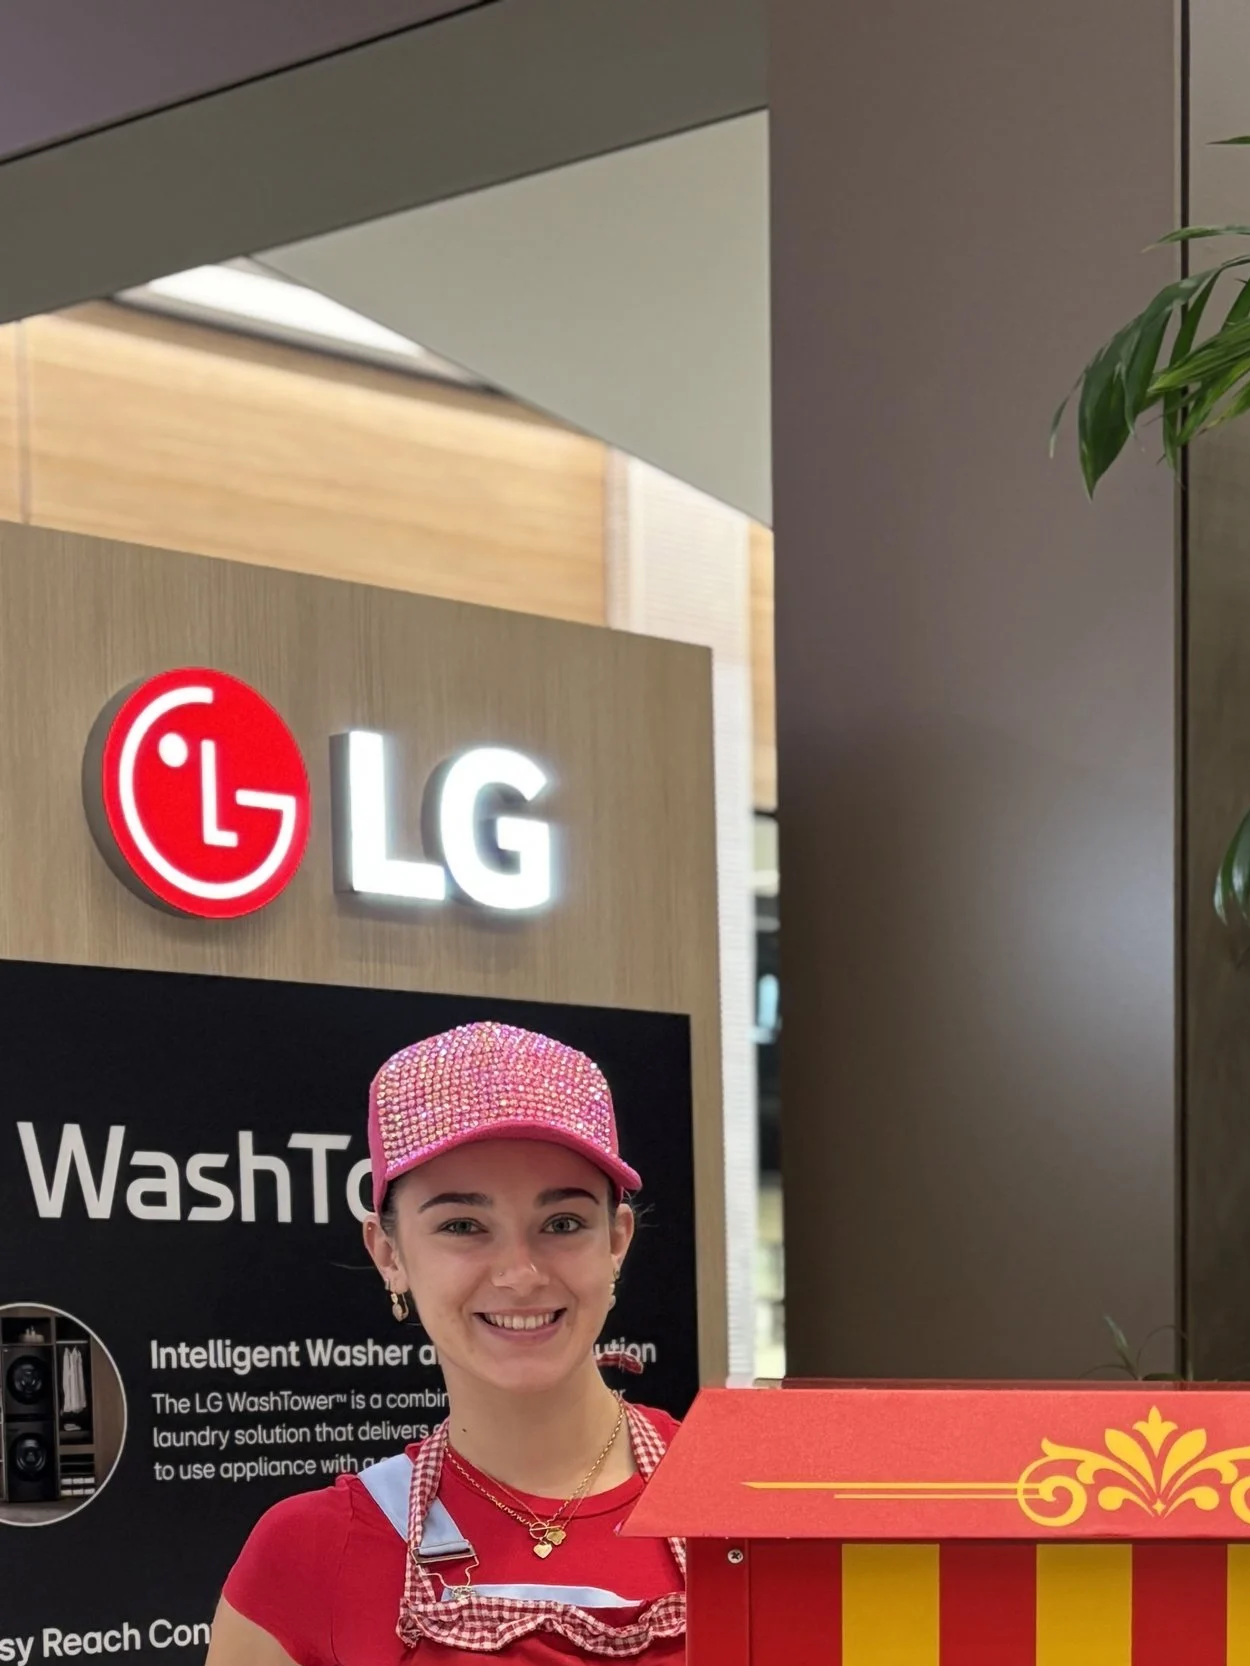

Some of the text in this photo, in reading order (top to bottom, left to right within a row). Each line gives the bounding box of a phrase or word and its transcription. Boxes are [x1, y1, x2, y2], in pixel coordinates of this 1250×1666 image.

[348, 730, 552, 910] LG
[151, 1339, 300, 1375] Intelligent
[306, 1338, 413, 1367] Washer
[152, 1393, 191, 1414] The
[195, 1392, 222, 1413] LG
[351, 1389, 366, 1410] is
[370, 1395, 382, 1409] a
[153, 1427, 230, 1450] laundry
[234, 1424, 311, 1445] solution
[314, 1422, 354, 1443] that
[358, 1420, 429, 1441] delivers
[153, 1461, 175, 1480] to
[179, 1463, 216, 1480] use
[219, 1457, 317, 1483] appliance
[321, 1453, 358, 1474] with
[42, 1622, 141, 1658] Reach
